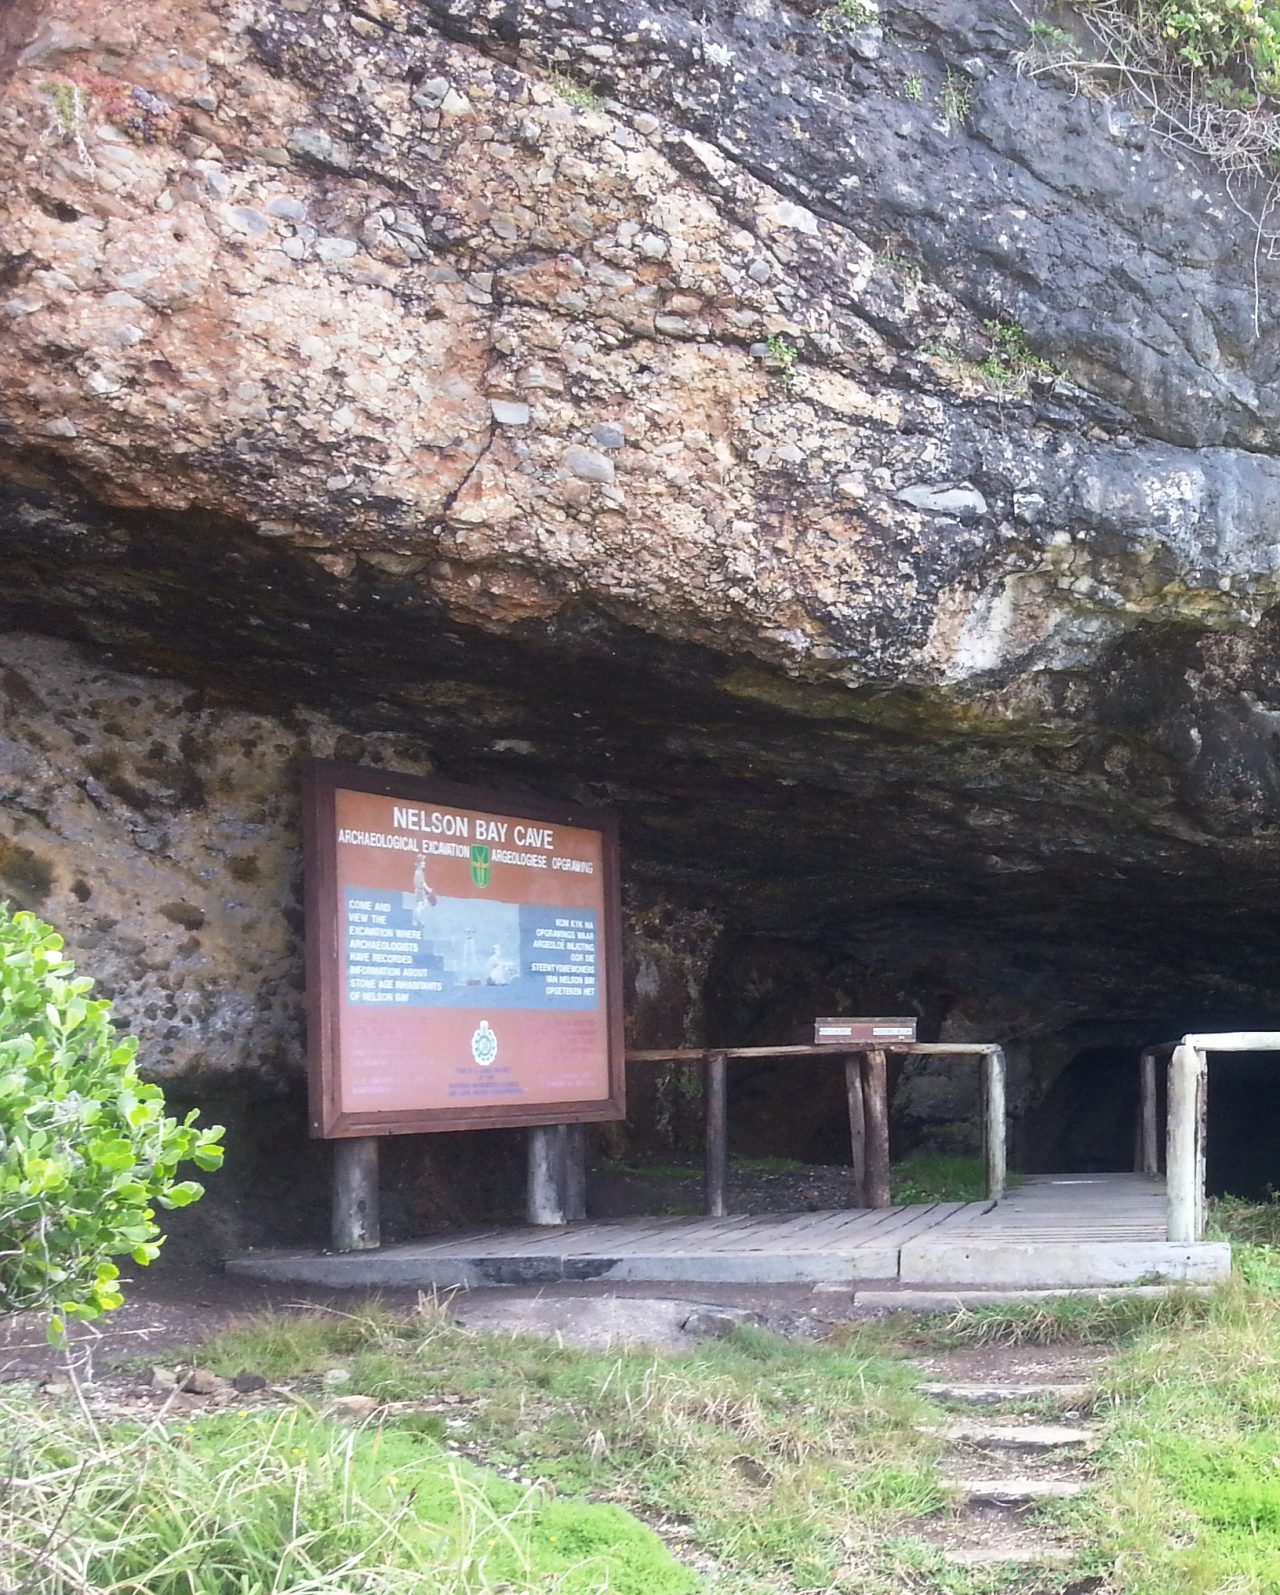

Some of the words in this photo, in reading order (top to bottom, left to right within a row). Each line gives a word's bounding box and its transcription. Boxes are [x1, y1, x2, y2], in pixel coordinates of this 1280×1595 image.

[394, 807, 468, 837] NELSON
[476, 820, 508, 842] BAY
[514, 826, 554, 850] CAVE
[338, 829, 419, 853] ARCHAEOLOGICAL
[422, 840, 470, 858] EXCAVATION
[491, 849, 547, 869] ARGEOLOGIESE
[552, 857, 593, 874] OPGRAWING
[349, 899, 372, 911] COME
[374, 902, 391, 913] AND
[348, 912, 368, 923] VIEW
[371, 914, 387, 925] THE
[349, 952, 370, 962] HAVE
[372, 953, 413, 964] RECORDED
[402, 968, 428, 977] ABOUT
[350, 978, 376, 989] STONE
[378, 980, 394, 990] AGE
[350, 991, 360, 1001] OF
[362, 992, 393, 1002] NELSON
